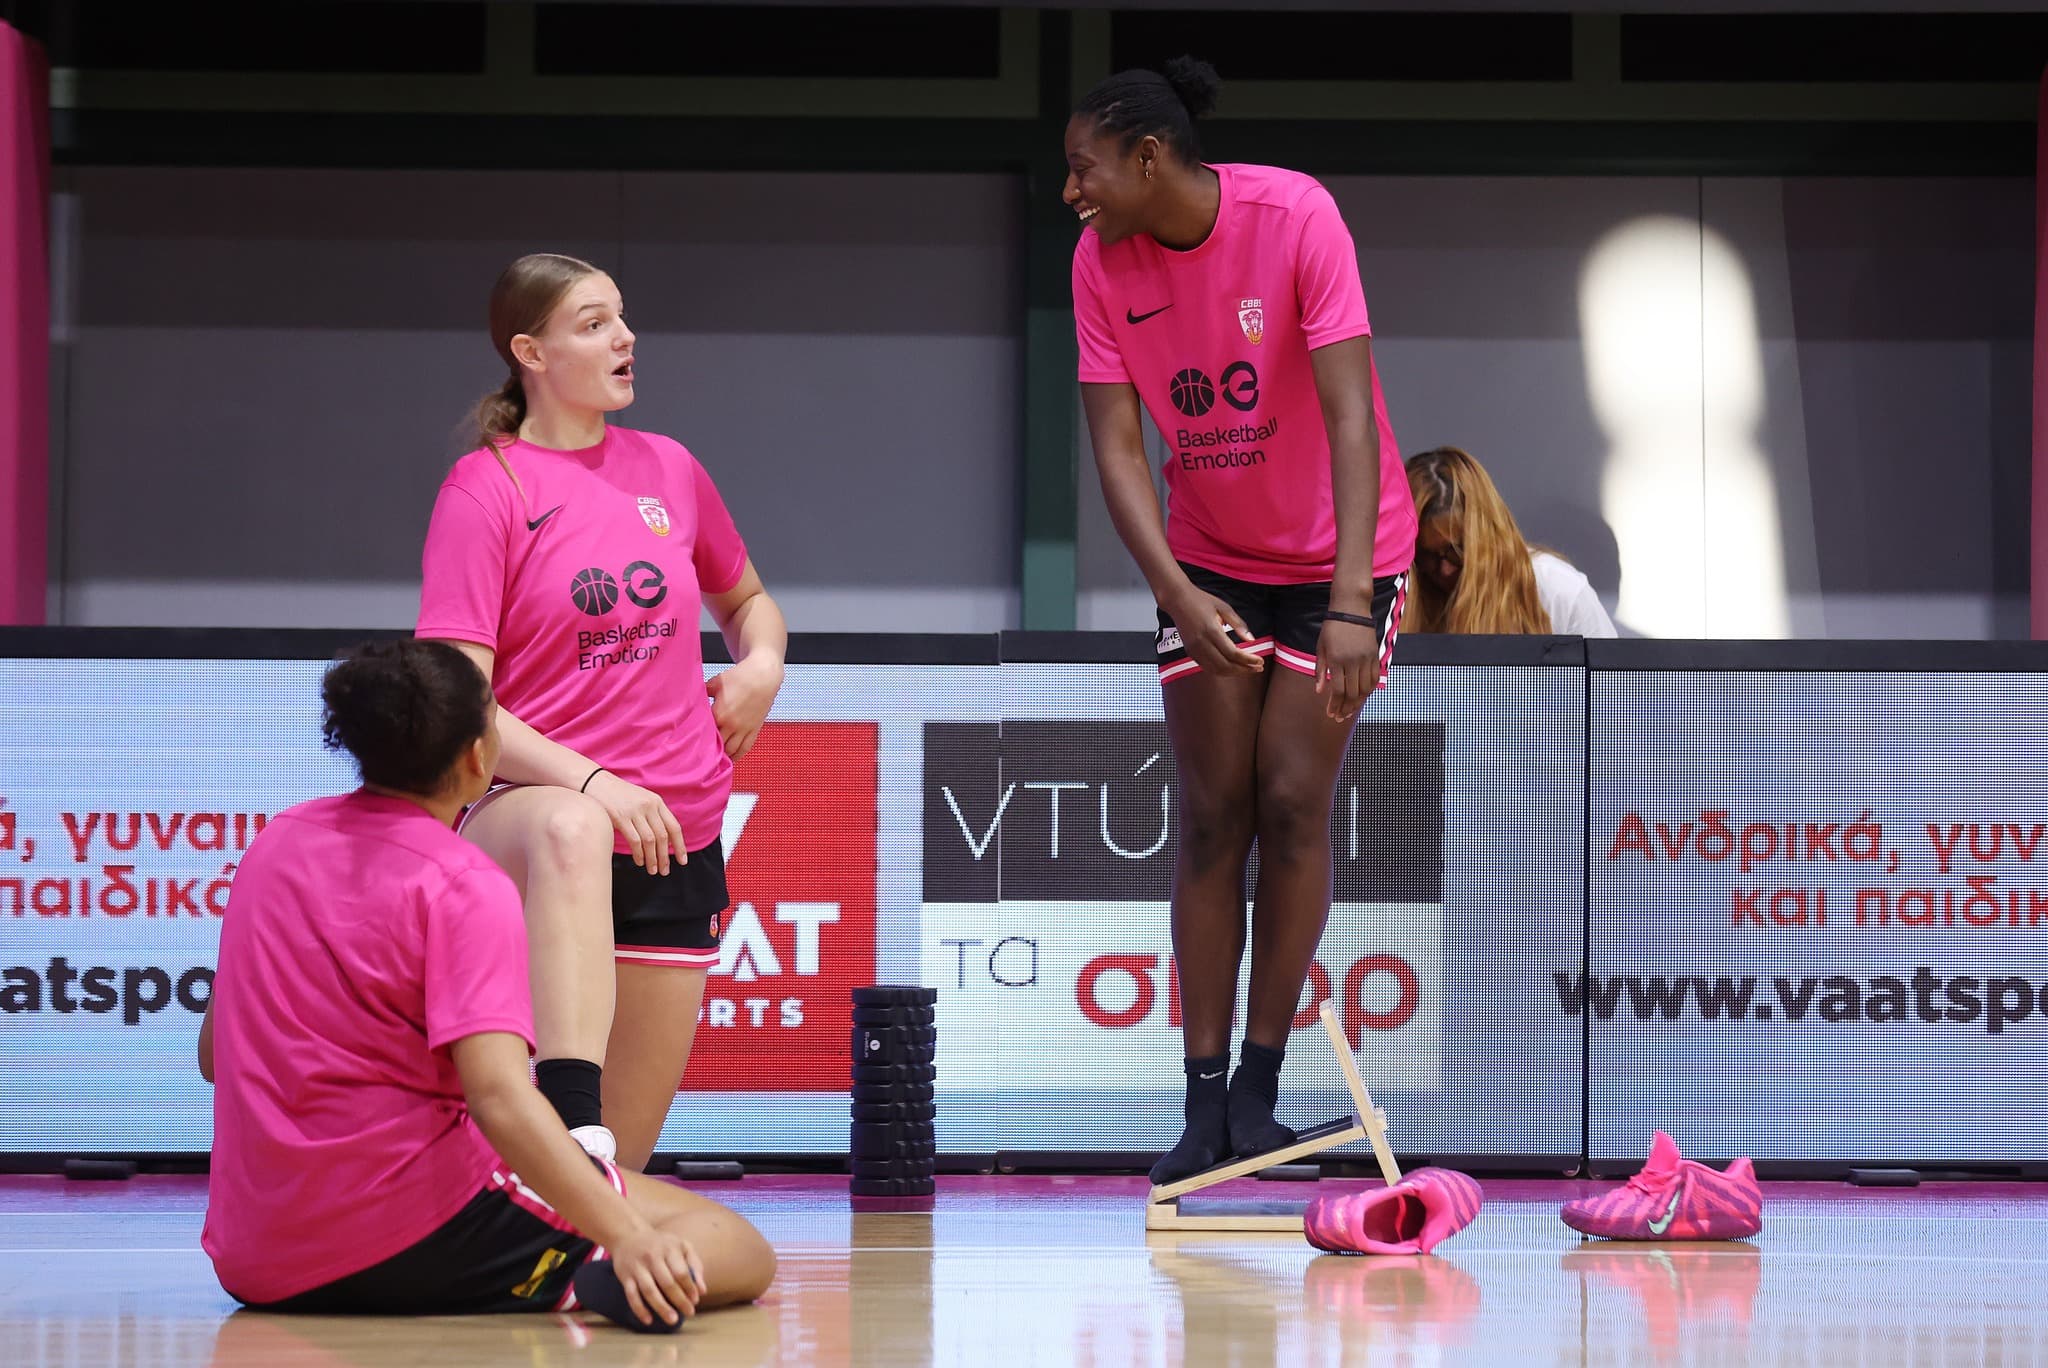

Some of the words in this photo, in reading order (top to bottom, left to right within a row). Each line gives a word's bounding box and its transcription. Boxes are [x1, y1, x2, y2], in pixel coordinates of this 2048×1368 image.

[1177, 417, 1278, 449] Basketball
[1181, 448, 1266, 471] Emotion
[578, 618, 677, 650] Basketball
[579, 645, 659, 671] Emotion
[1607, 810, 1900, 874] Ανδρικά,
[1732, 888, 1828, 926] και
[0, 957, 216, 1026] atspo
[1552, 967, 2048, 1034] www.vaatsp
[698, 997, 806, 1027] RTS
